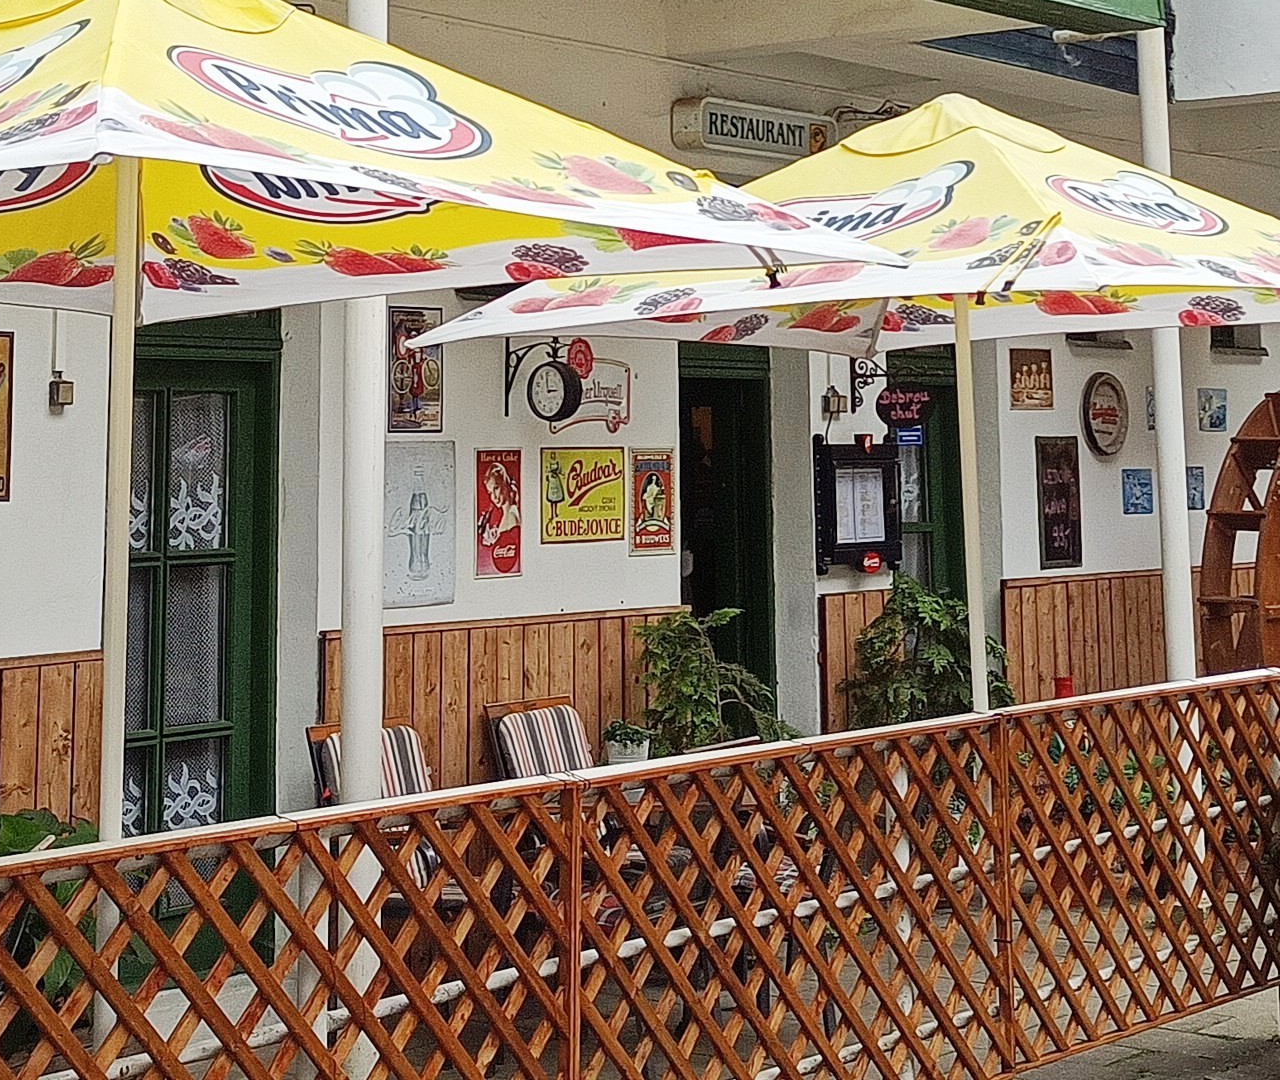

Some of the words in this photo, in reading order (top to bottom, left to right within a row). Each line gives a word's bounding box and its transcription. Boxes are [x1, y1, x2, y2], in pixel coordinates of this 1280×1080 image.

[211, 63, 442, 140] Prima
[707, 111, 805, 148] RESTAURANT
[567, 458, 622, 500] Budvar
